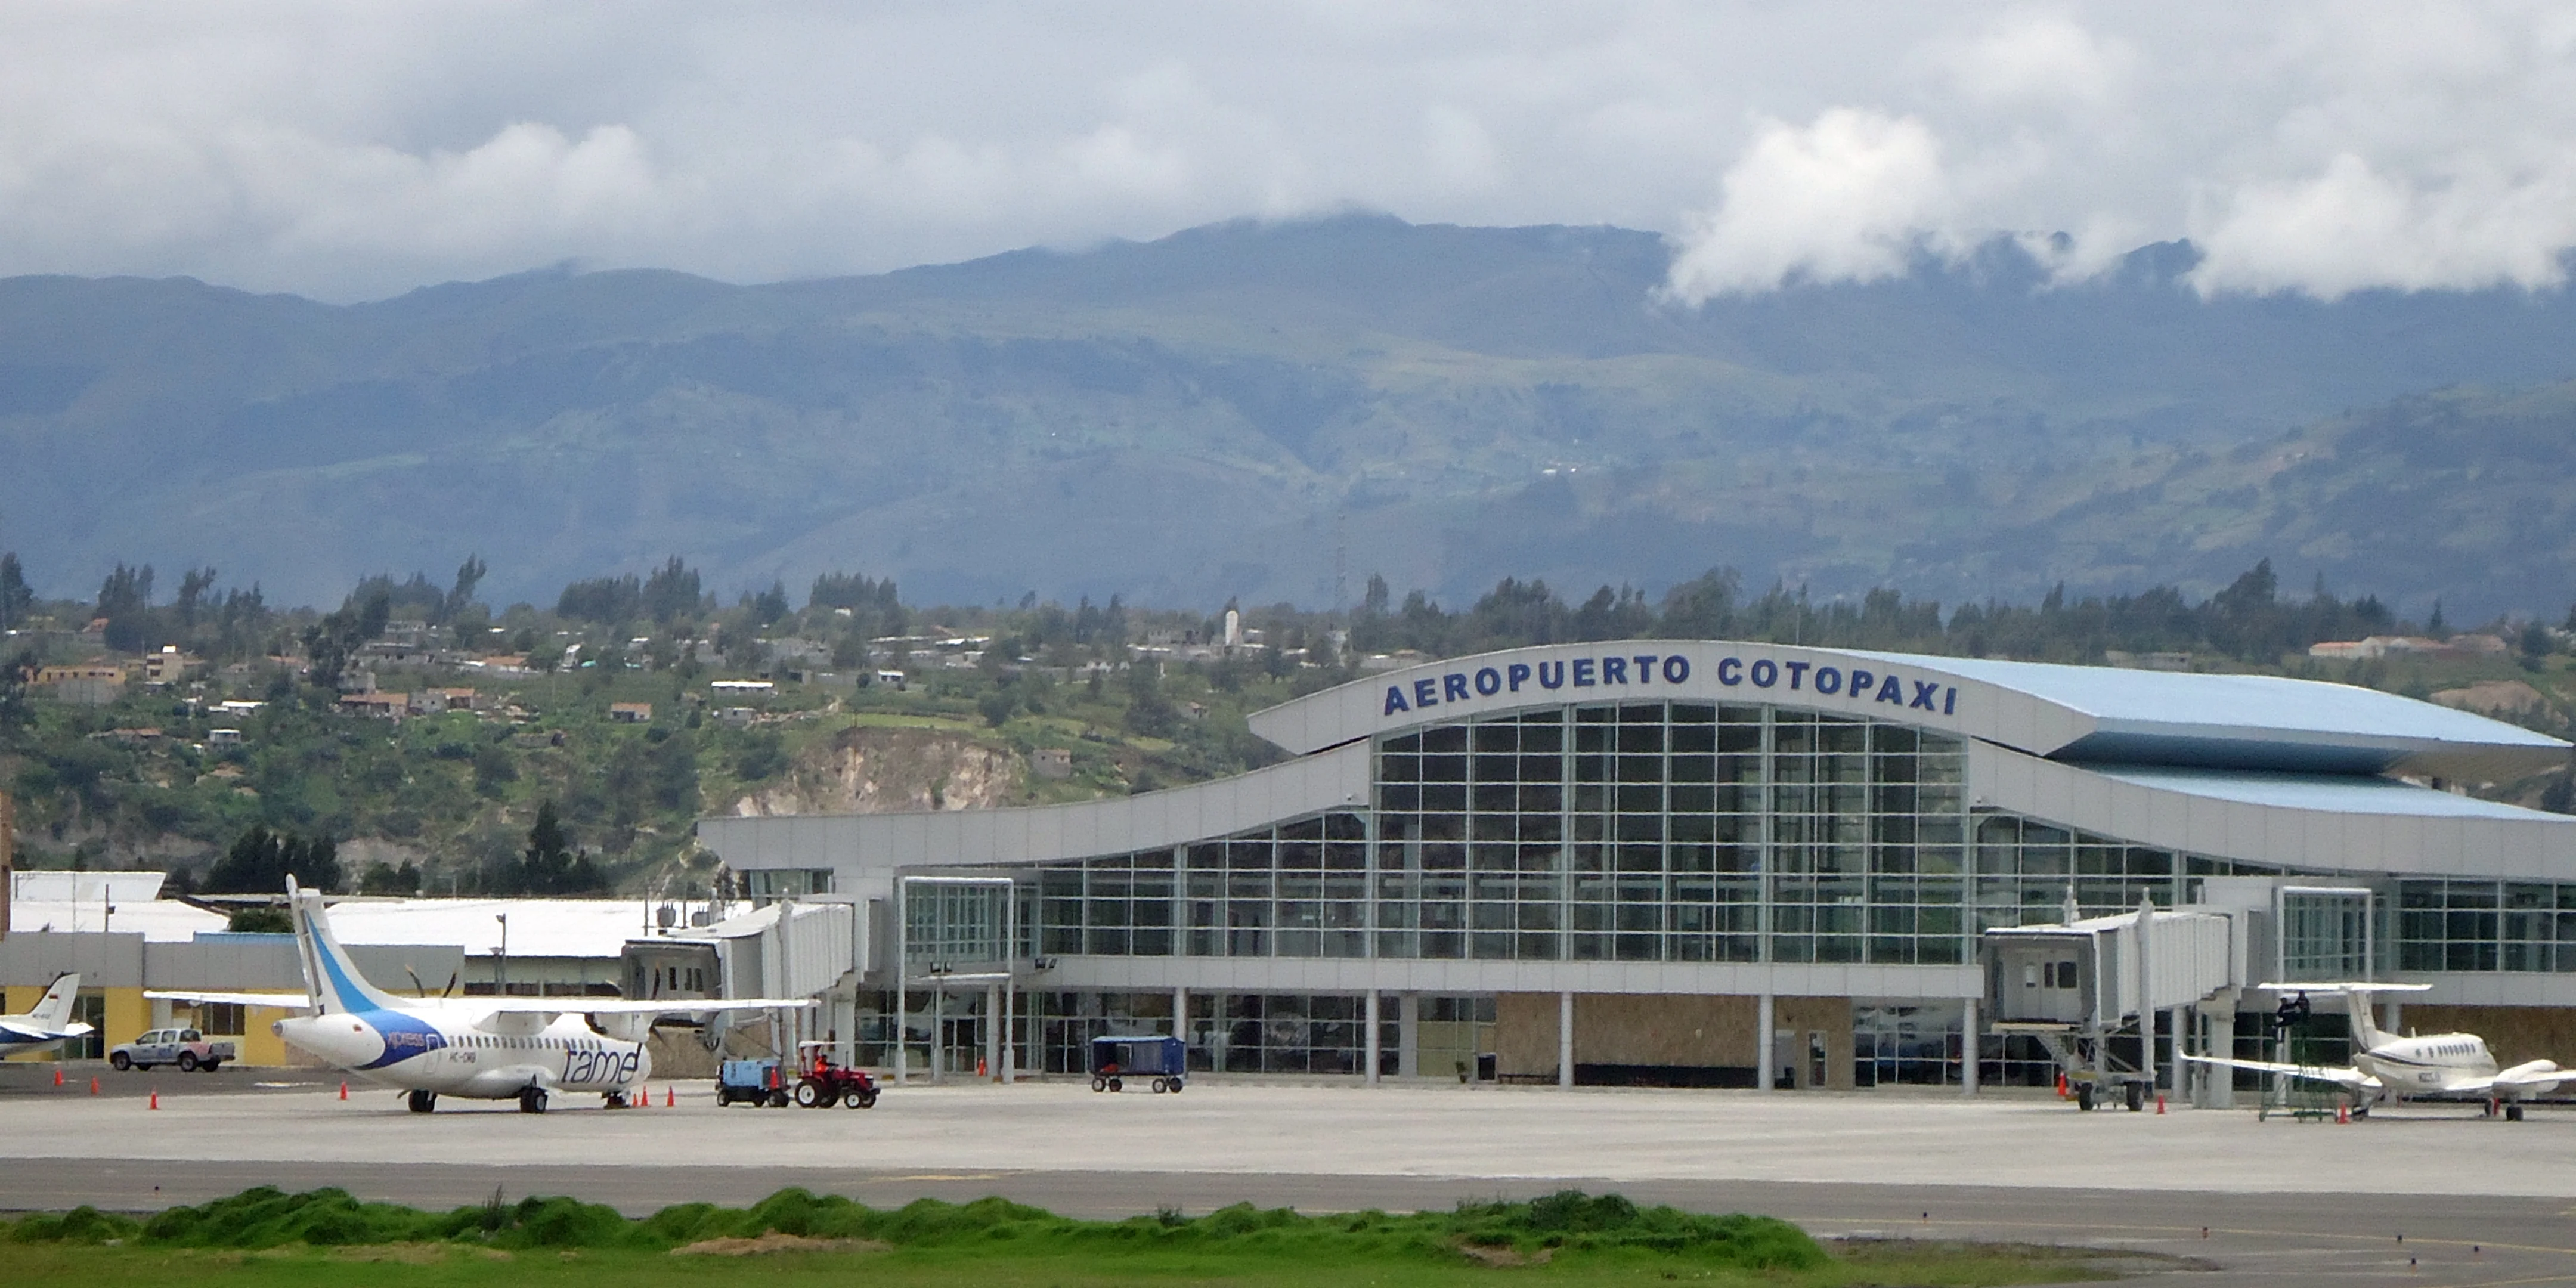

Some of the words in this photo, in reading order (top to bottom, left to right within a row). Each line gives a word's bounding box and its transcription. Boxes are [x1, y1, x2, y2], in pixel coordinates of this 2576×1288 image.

[1384, 655, 1690, 715] AEROPUERTO
[1718, 657, 1956, 715] COTOPAXI
[562, 1039, 642, 1084] tame
